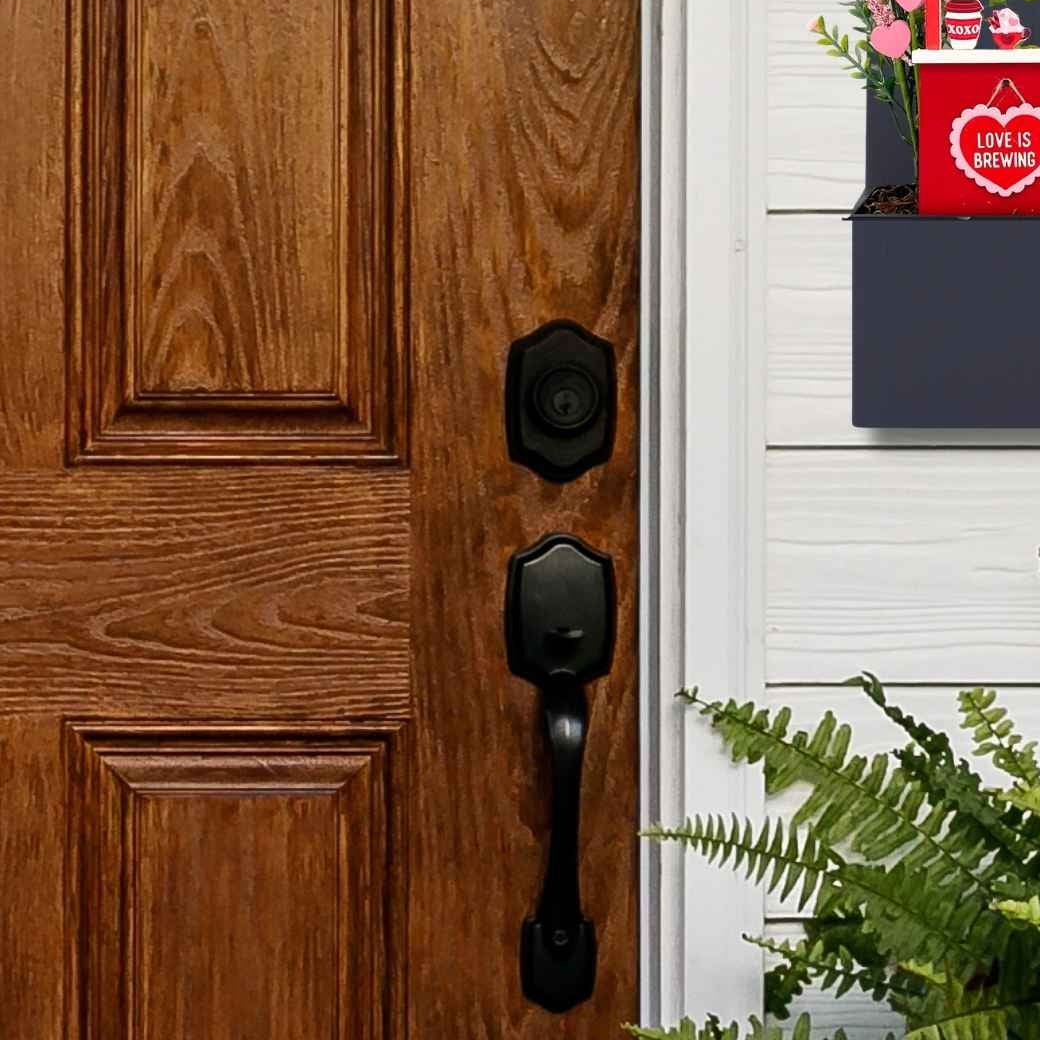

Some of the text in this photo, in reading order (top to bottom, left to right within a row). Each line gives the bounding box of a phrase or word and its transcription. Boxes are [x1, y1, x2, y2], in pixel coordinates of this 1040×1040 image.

[977, 131, 1032, 149] LOVE IS
[973, 151, 1036, 169] BREWING
